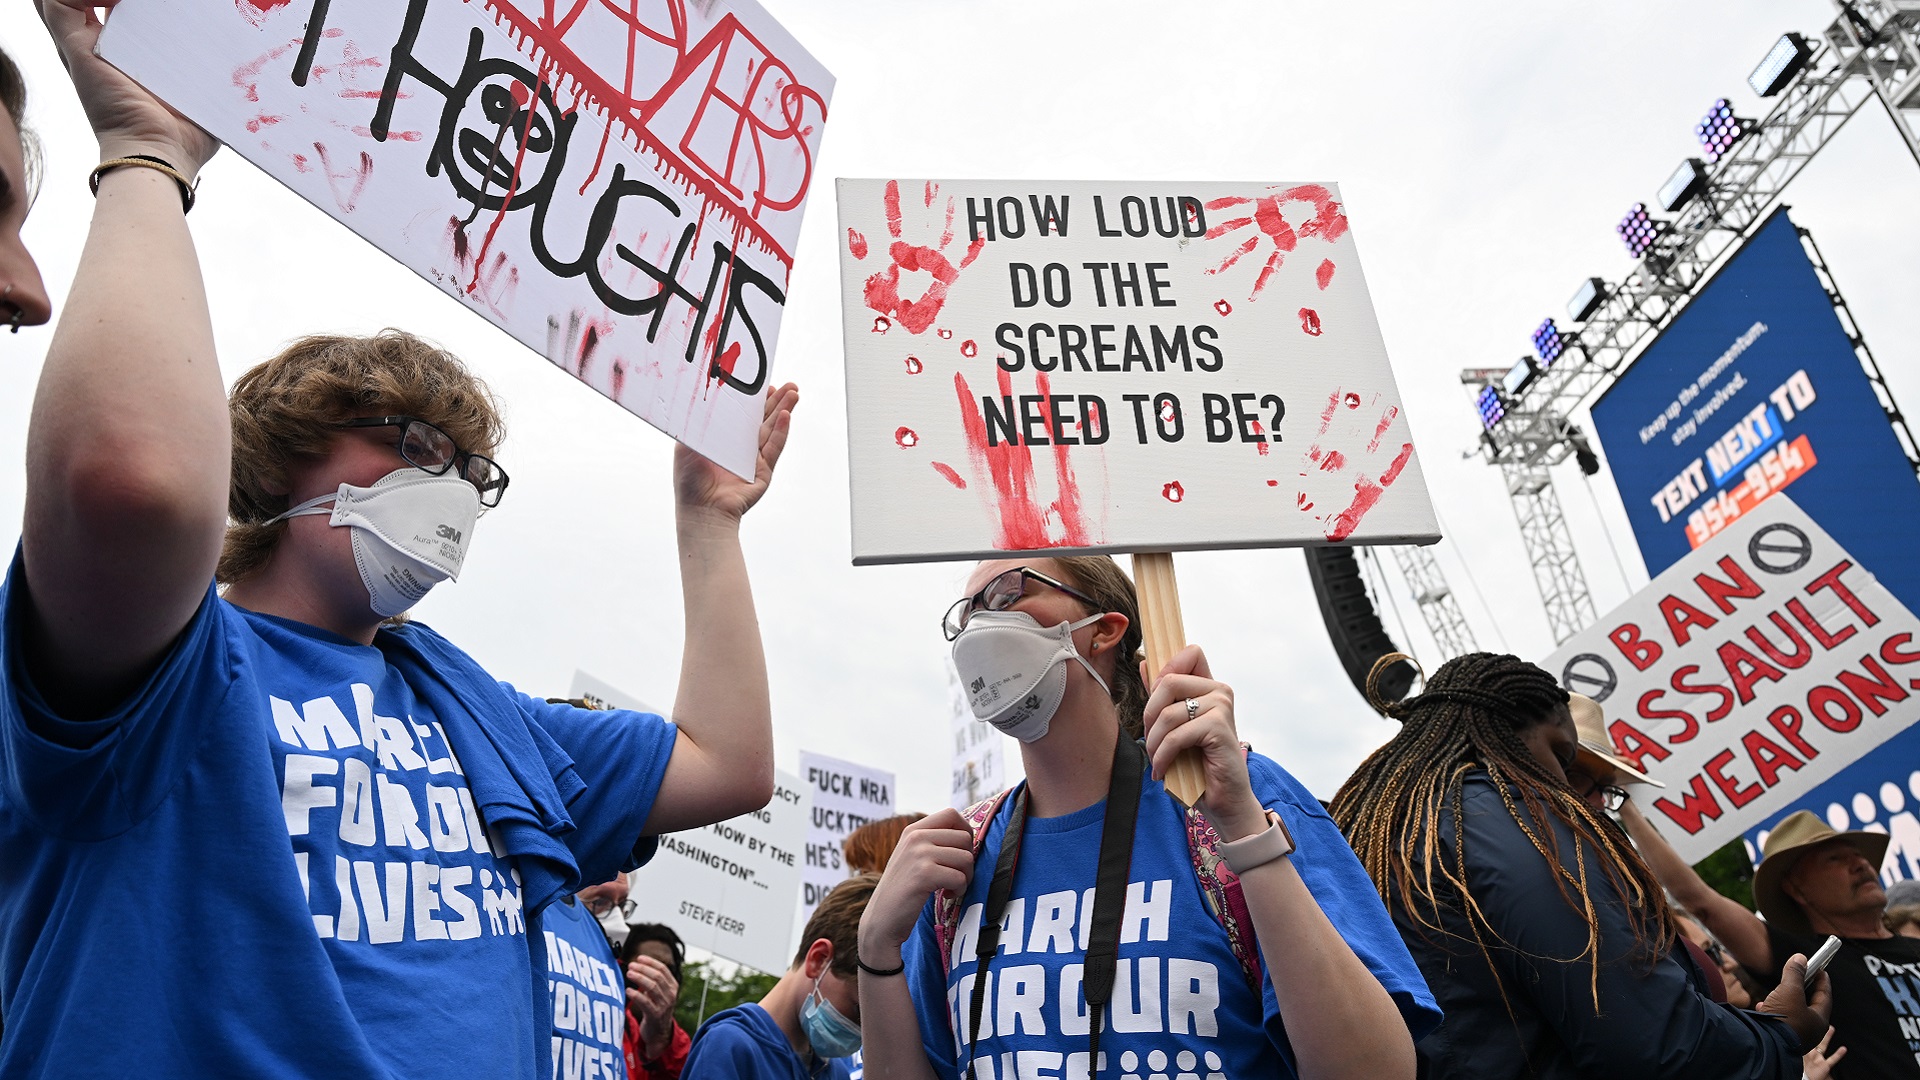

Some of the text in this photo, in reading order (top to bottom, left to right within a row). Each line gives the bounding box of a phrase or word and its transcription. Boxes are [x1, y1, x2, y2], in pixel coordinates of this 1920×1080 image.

[966, 194, 1208, 242] HOW LOUD
[1008, 262, 1177, 309] DO THE
[994, 322, 1225, 374] SCREAMS
[982, 391, 1287, 448] NEED TO BE?
[1639, 413, 1668, 445] Keep
[1665, 400, 1682, 420] up
[1678, 382, 1700, 407] the
[1672, 371, 1748, 446] stay involved.
[1650, 368, 1817, 524] TEXT NEXT TO
[1687, 439, 1806, 544] 954-954
[435, 524, 462, 545] 3M
[1608, 554, 1765, 672] BAN
[970, 676, 986, 695] 3M
[1608, 559, 1881, 774] ASSAULT
[1653, 632, 1920, 836] WEAPONS
[281, 754, 430, 850] FOR
[808, 767, 890, 806] FUCK NRA
[713, 823, 796, 867] NOW BY THE
[811, 806, 845, 835] UCK
[805, 840, 841, 870] HE'S
[294, 851, 481, 944] LIVES
[678, 901, 746, 937] STEVE KERR
[1059, 957, 1220, 1038] OUR
